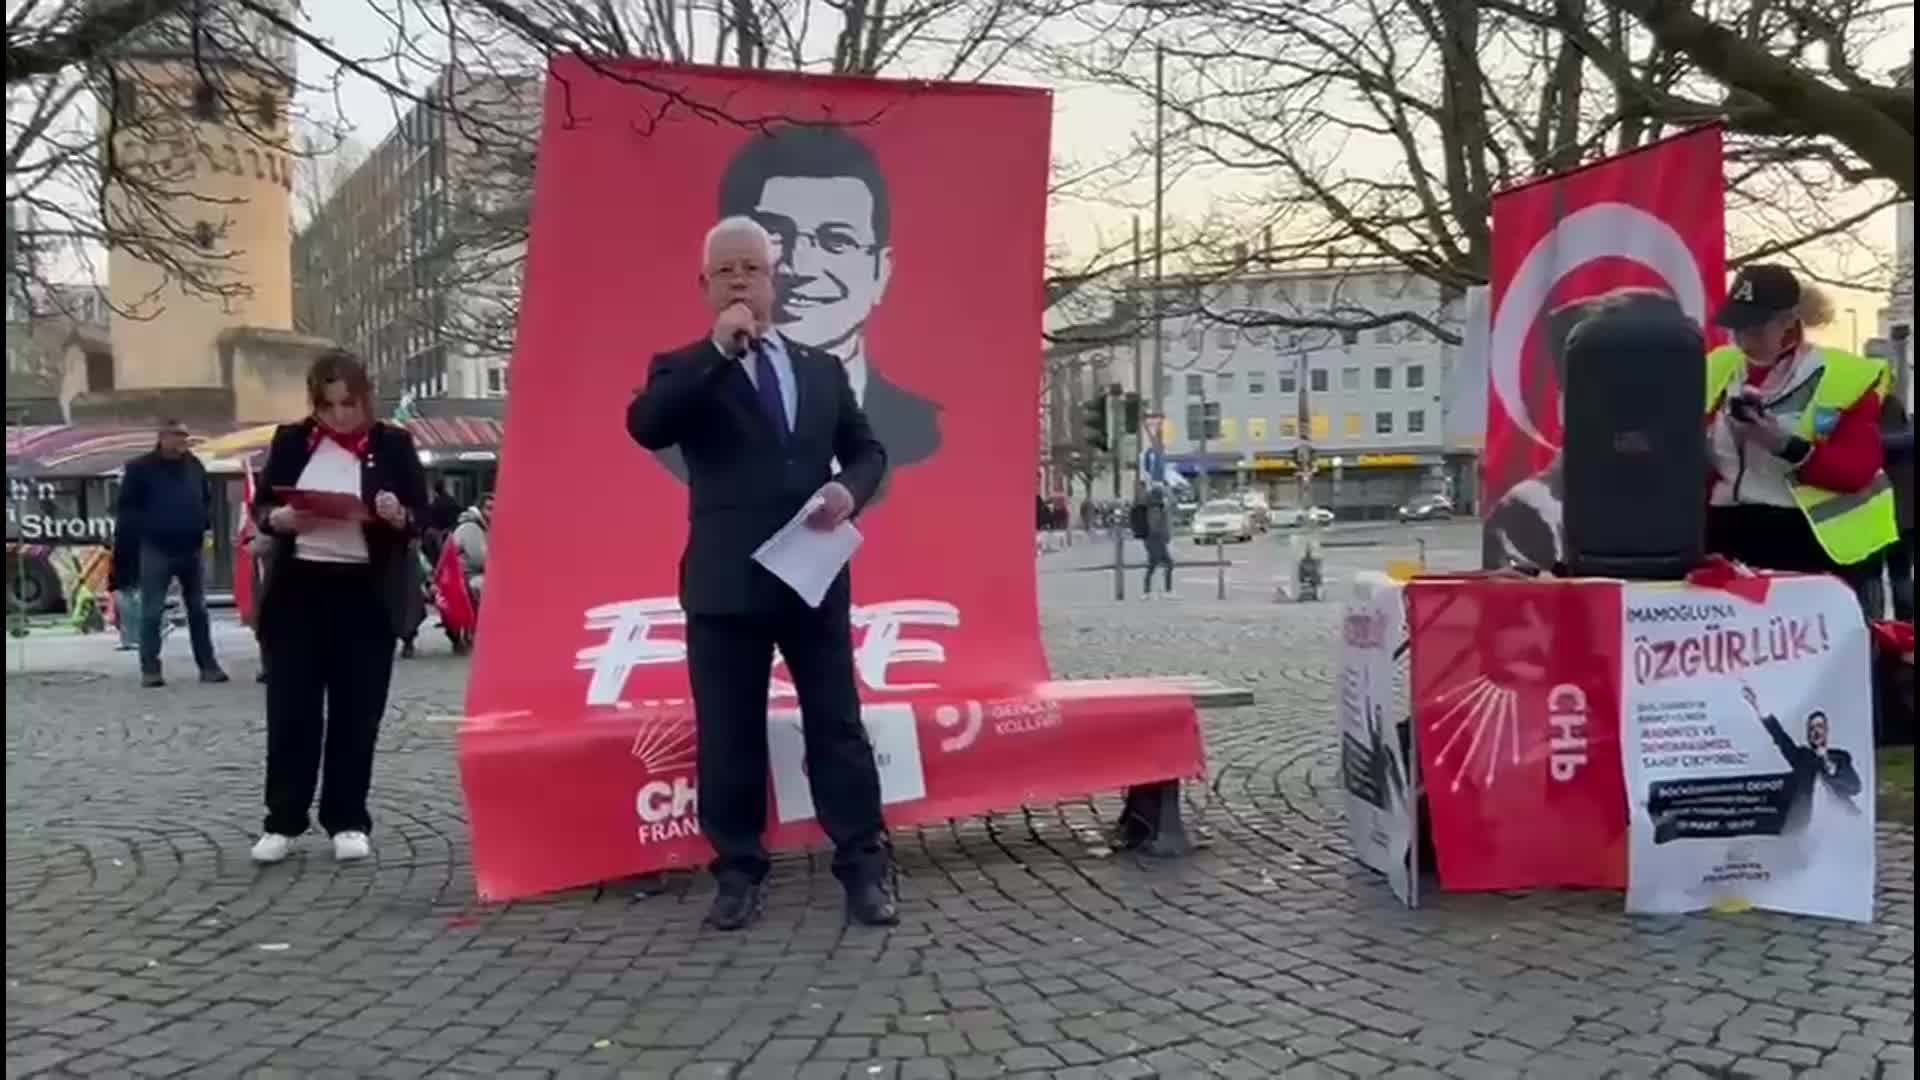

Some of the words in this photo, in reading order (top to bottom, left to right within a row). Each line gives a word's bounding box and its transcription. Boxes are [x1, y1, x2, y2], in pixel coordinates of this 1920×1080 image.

[573, 596, 960, 706] FE
[1634, 613, 1831, 685] ÖZGÜRLÜK!
[636, 777, 699, 822] CH
[638, 817, 700, 845] FRAN
